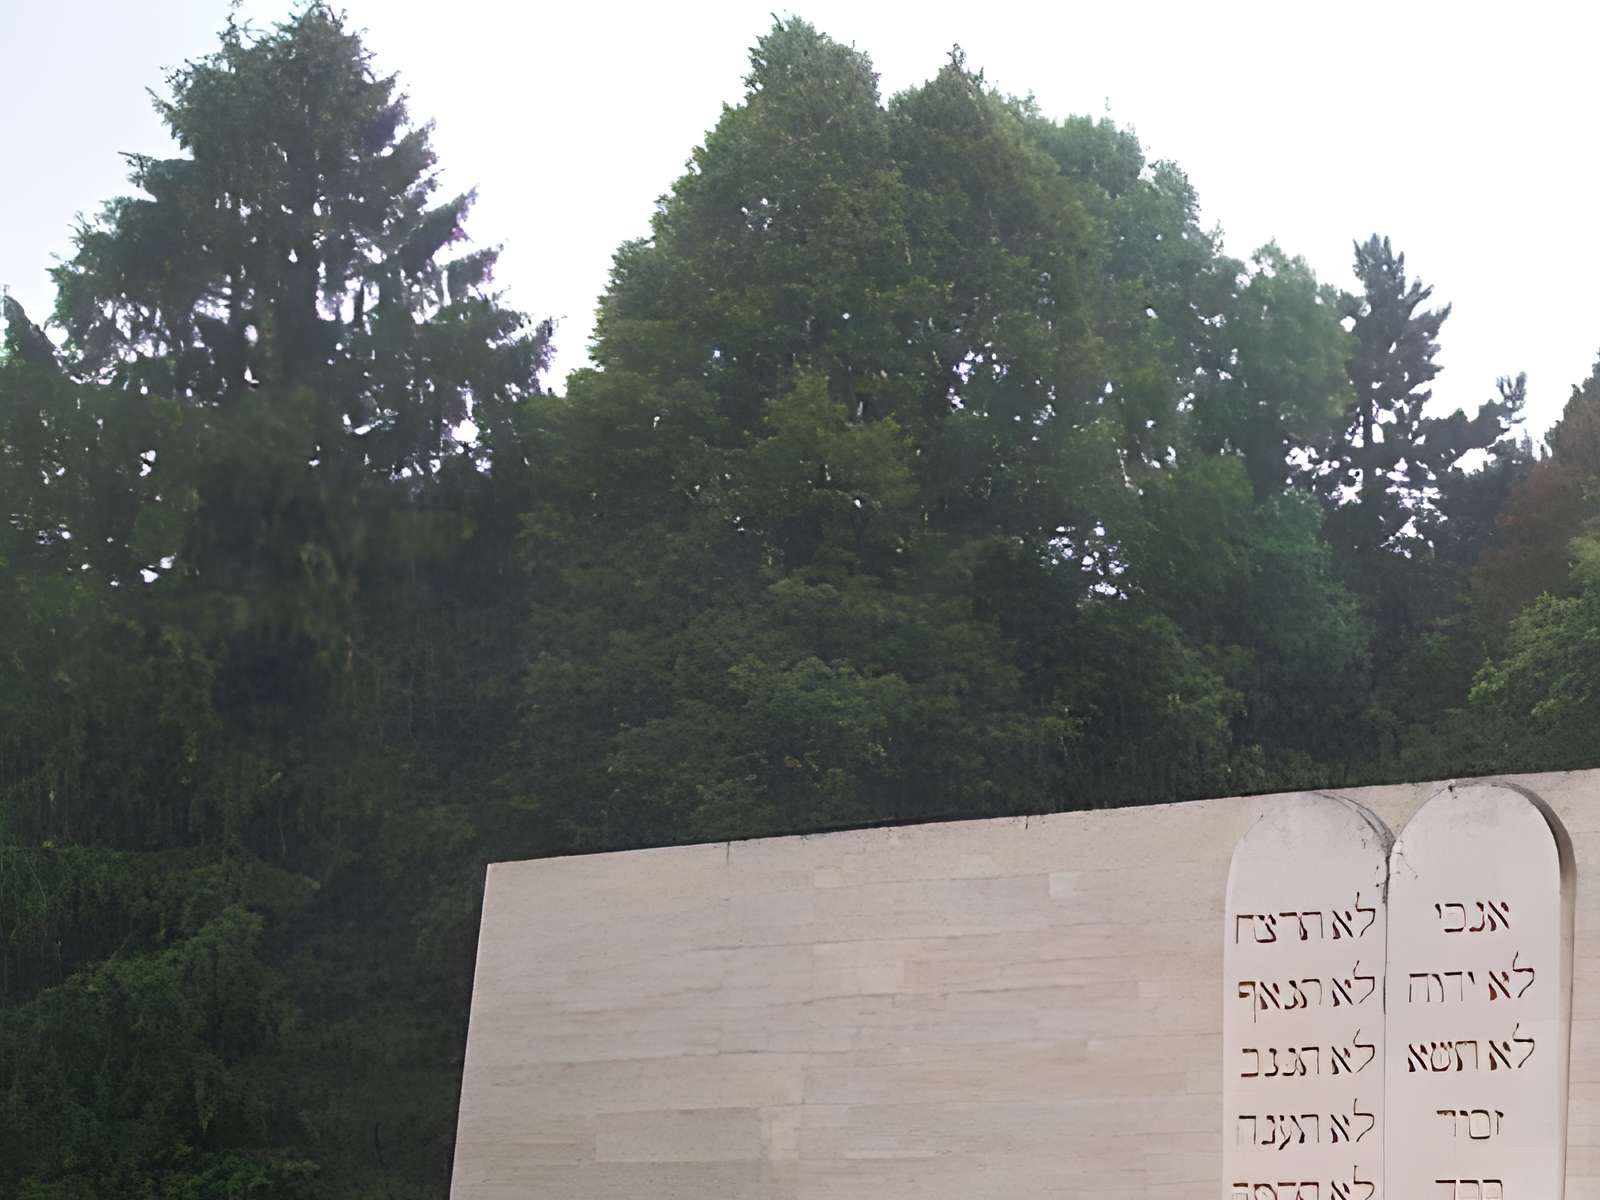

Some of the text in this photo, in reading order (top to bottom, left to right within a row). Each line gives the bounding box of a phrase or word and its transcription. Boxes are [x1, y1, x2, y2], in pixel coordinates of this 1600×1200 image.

[1332, 891, 1376, 940] לא
[1435, 900, 1510, 933] אנכי
[1331, 960, 1375, 1007] לא
[1488, 951, 1535, 1001] לא
[1331, 1029, 1376, 1075] לא
[1408, 1022, 1535, 1072] לא תשא
[1329, 1098, 1375, 1144] לא
